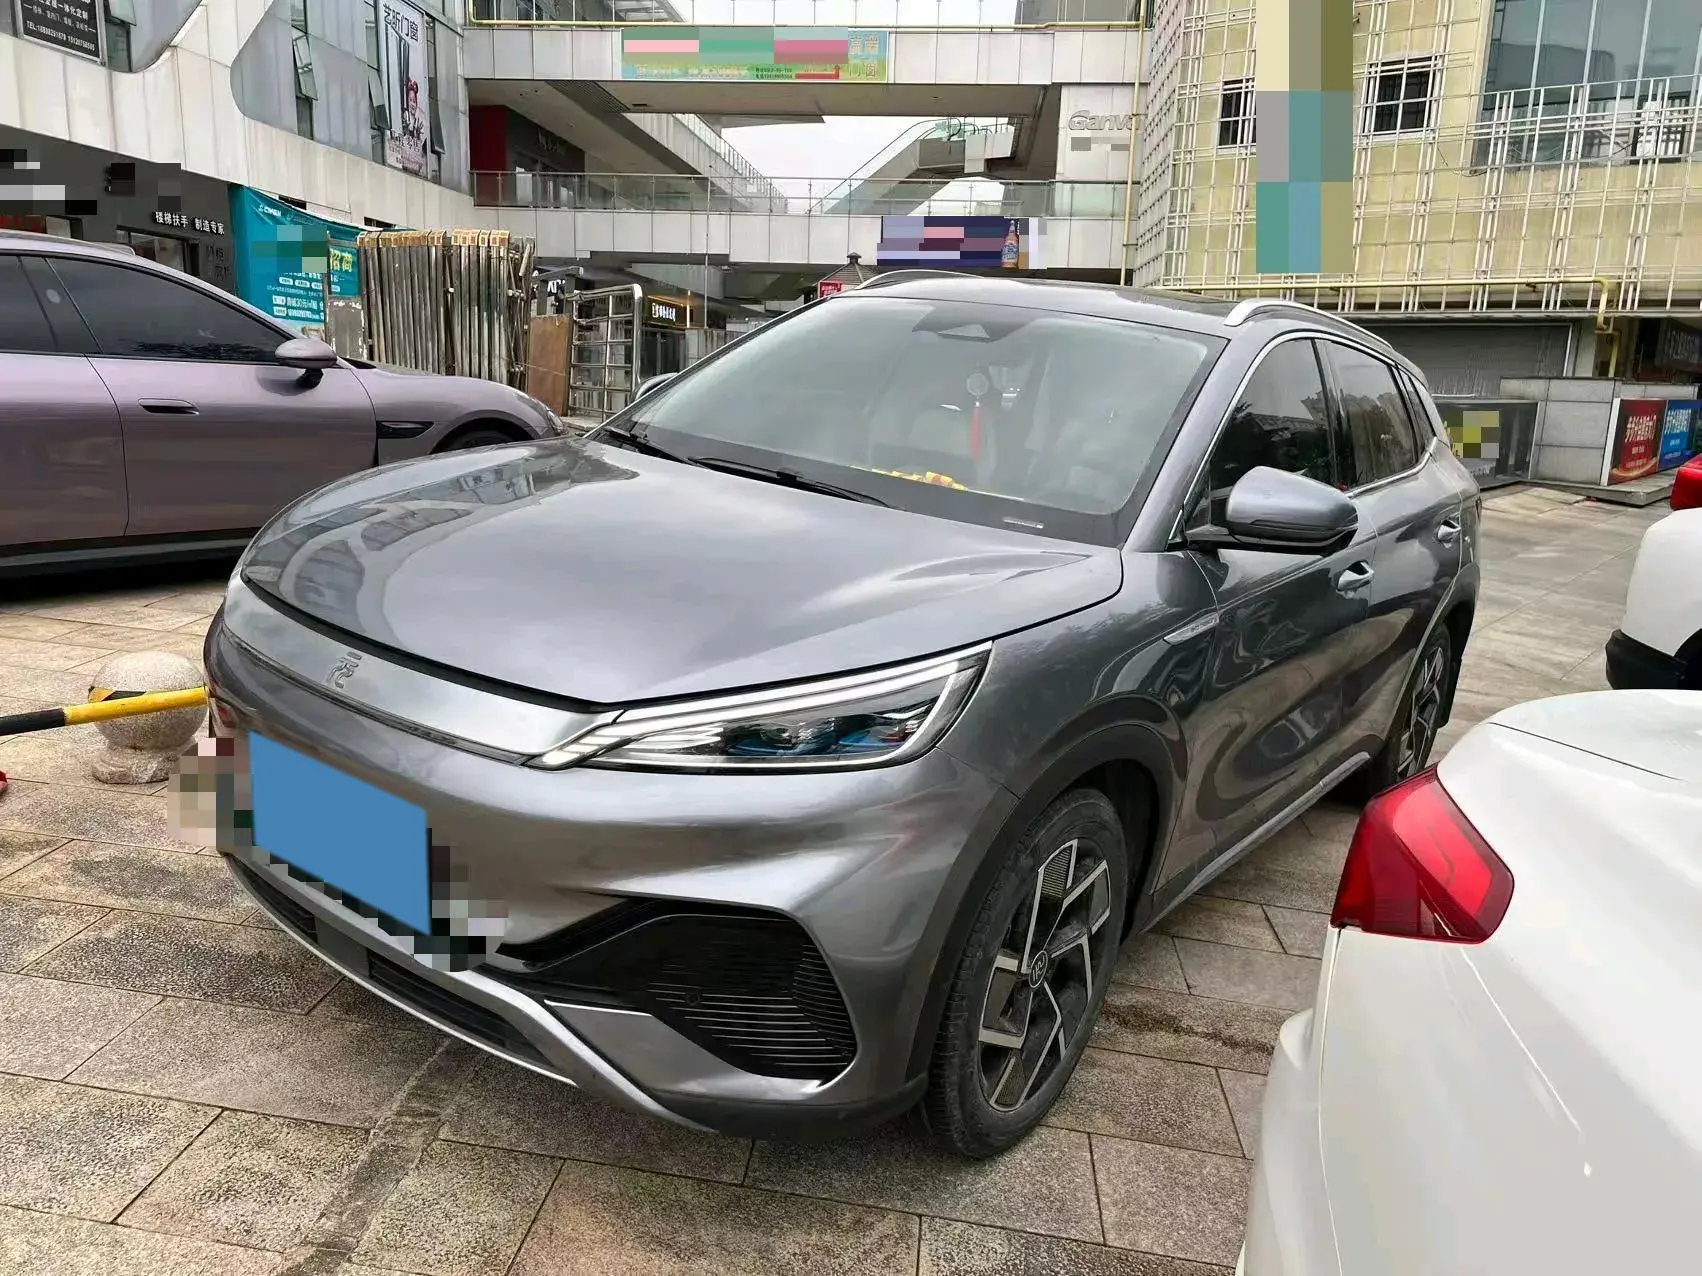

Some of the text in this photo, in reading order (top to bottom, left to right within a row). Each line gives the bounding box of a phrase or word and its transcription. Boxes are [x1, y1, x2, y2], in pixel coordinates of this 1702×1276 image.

[155, 211, 225, 235] 楼梯扶手 制造专家
